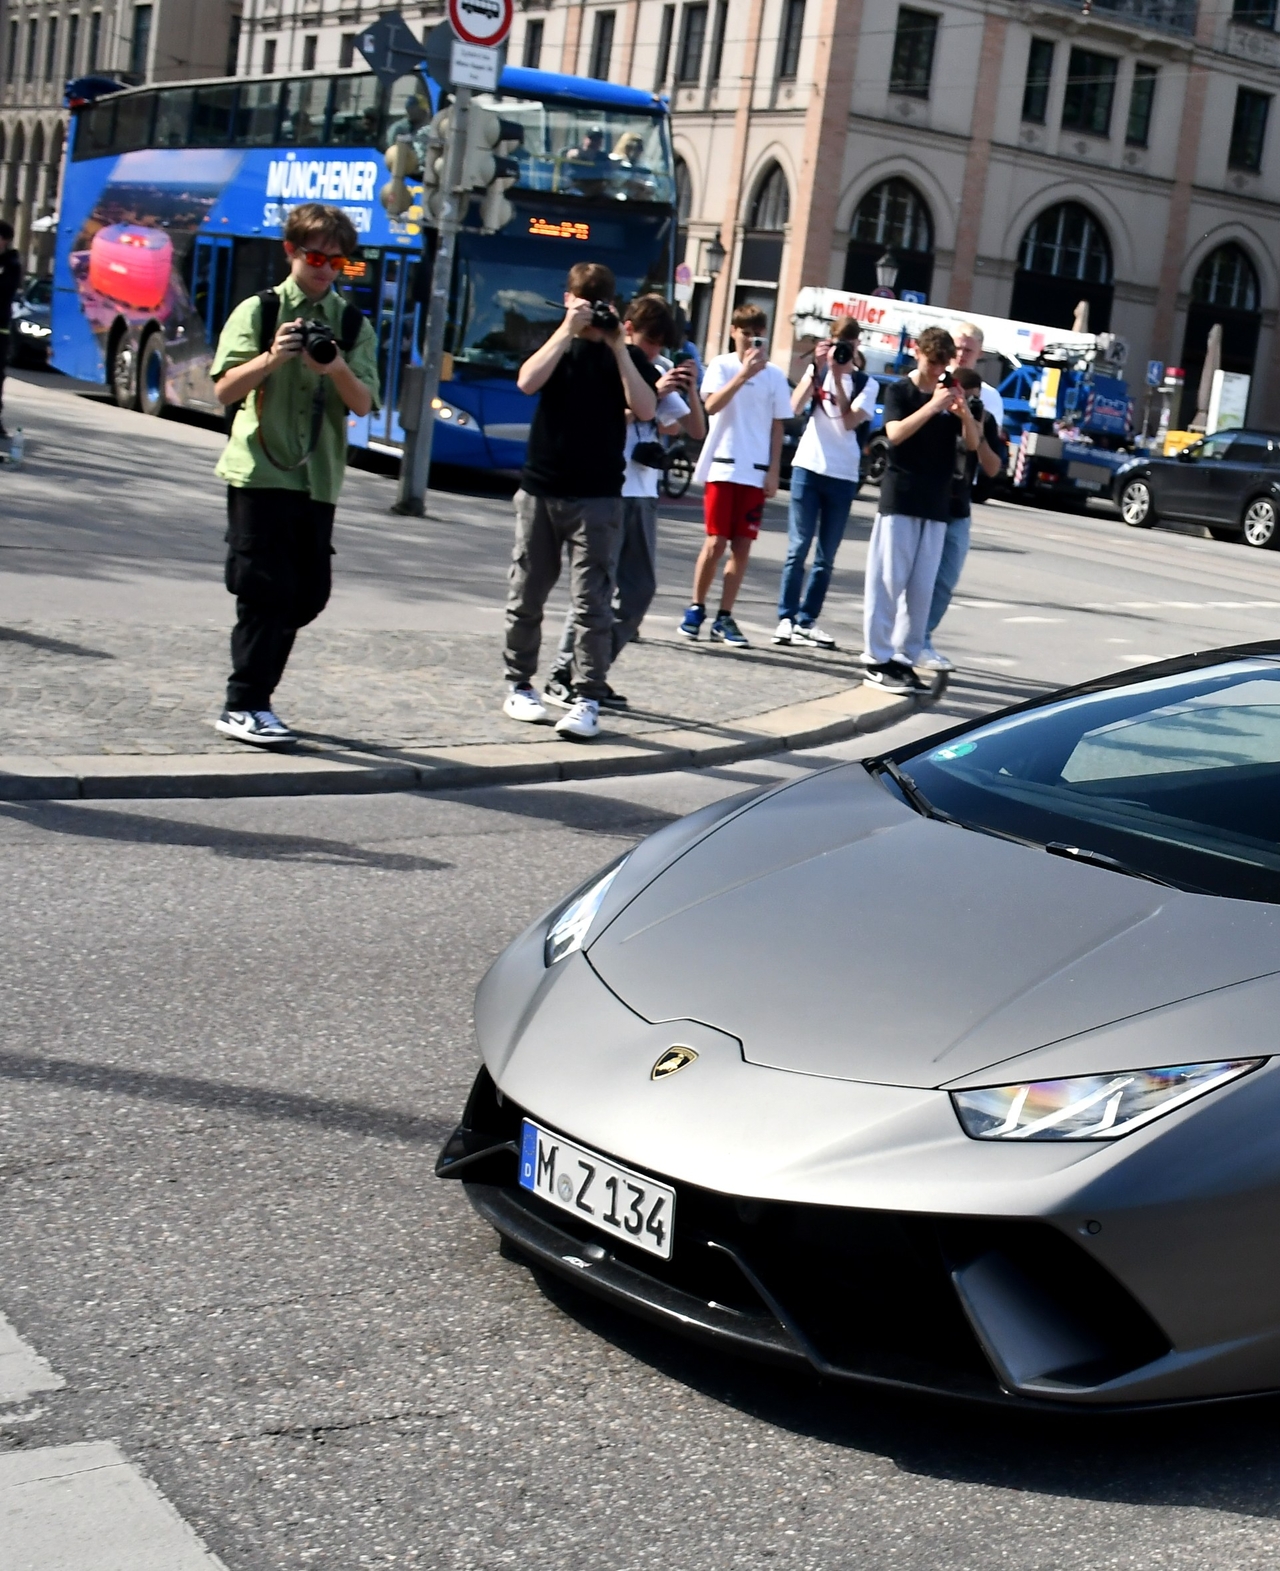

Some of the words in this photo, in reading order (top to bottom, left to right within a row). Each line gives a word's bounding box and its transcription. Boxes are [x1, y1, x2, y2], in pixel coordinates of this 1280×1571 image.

[266, 152, 378, 201] MÜNCHENER
[829, 297, 886, 324] müller
[537, 1138, 559, 1194] M
[575, 1159, 596, 1215] Z
[603, 1175, 666, 1247] 134
